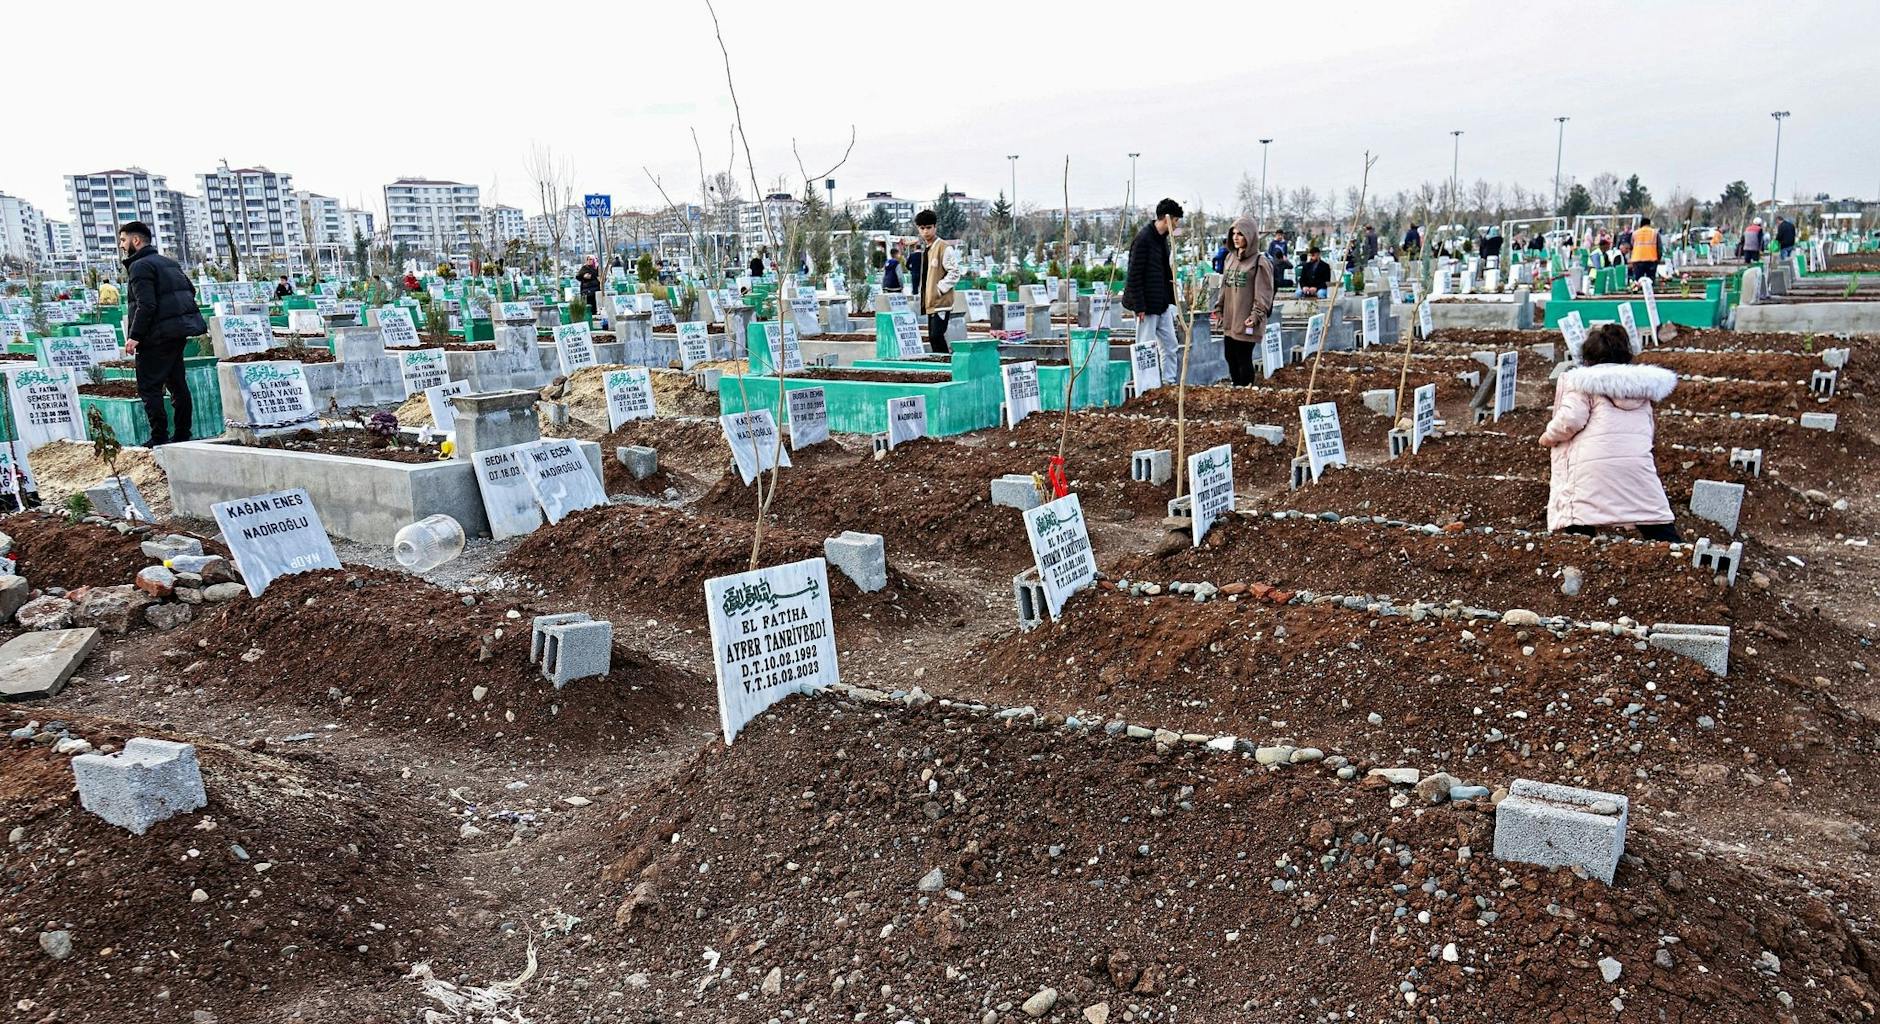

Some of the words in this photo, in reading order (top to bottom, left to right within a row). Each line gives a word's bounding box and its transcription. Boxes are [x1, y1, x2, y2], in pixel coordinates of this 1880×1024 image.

[276, 387, 303, 397] YAVUZ
[226, 499, 272, 519] KAĞAN
[272, 493, 304, 508] ENES
[242, 516, 309, 540] NADİROĞLU
[742, 619, 758, 635] EL
[763, 606, 809, 629] FATİHA
[726, 637, 762, 664] AYFER
[764, 617, 827, 653] TANRİVERDİ
[742, 645, 818, 678] D.T.10.02.1992
[744, 660, 820, 694] V.T.15.02.2023
